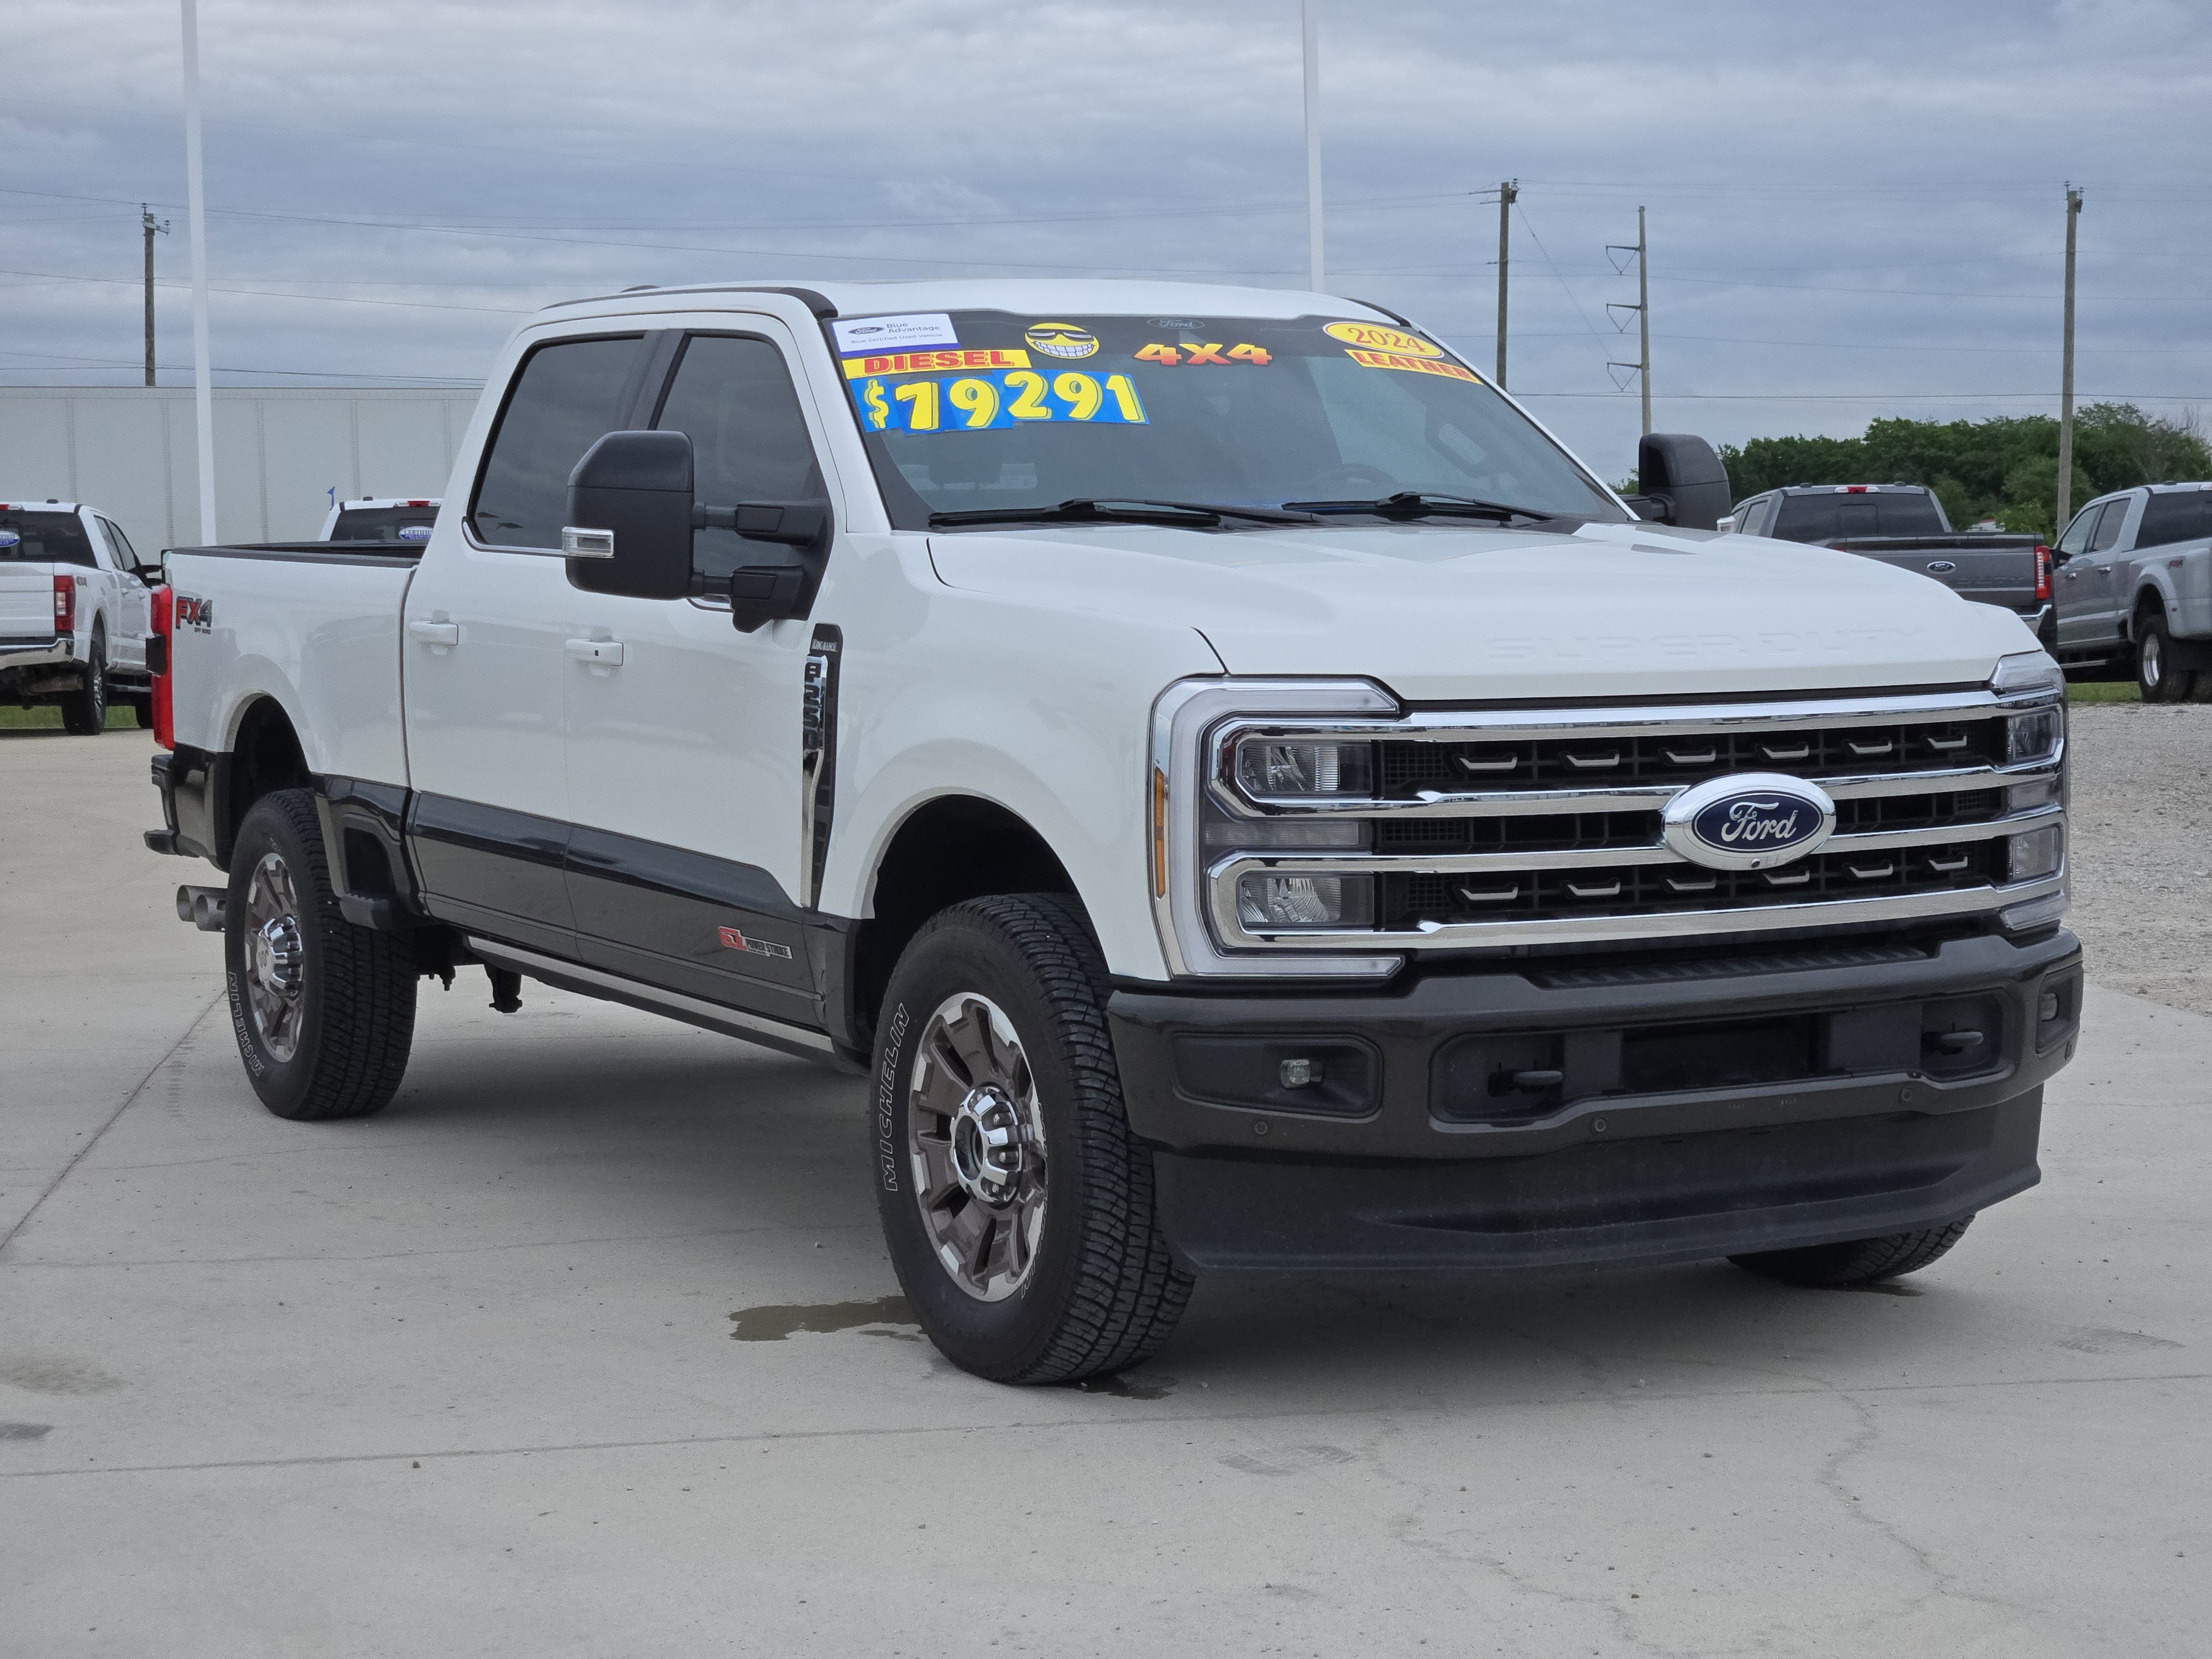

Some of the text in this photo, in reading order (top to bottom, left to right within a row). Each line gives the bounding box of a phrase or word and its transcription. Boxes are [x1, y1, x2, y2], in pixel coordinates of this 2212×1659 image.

[888, 325, 940, 334] Advantage
[1347, 327, 1427, 353] 2024
[864, 351, 1015, 375] DIESEL
[1134, 343, 1272, 366] 4X4
[1351, 351, 1479, 383] LEATHER
[863, 371, 1144, 430] $79291
[175, 596, 213, 630] FX4
[1721, 801, 1798, 842] Ford
[228, 971, 265, 1077] MICHELIN
[884, 1003, 912, 1192] MICHELIN
